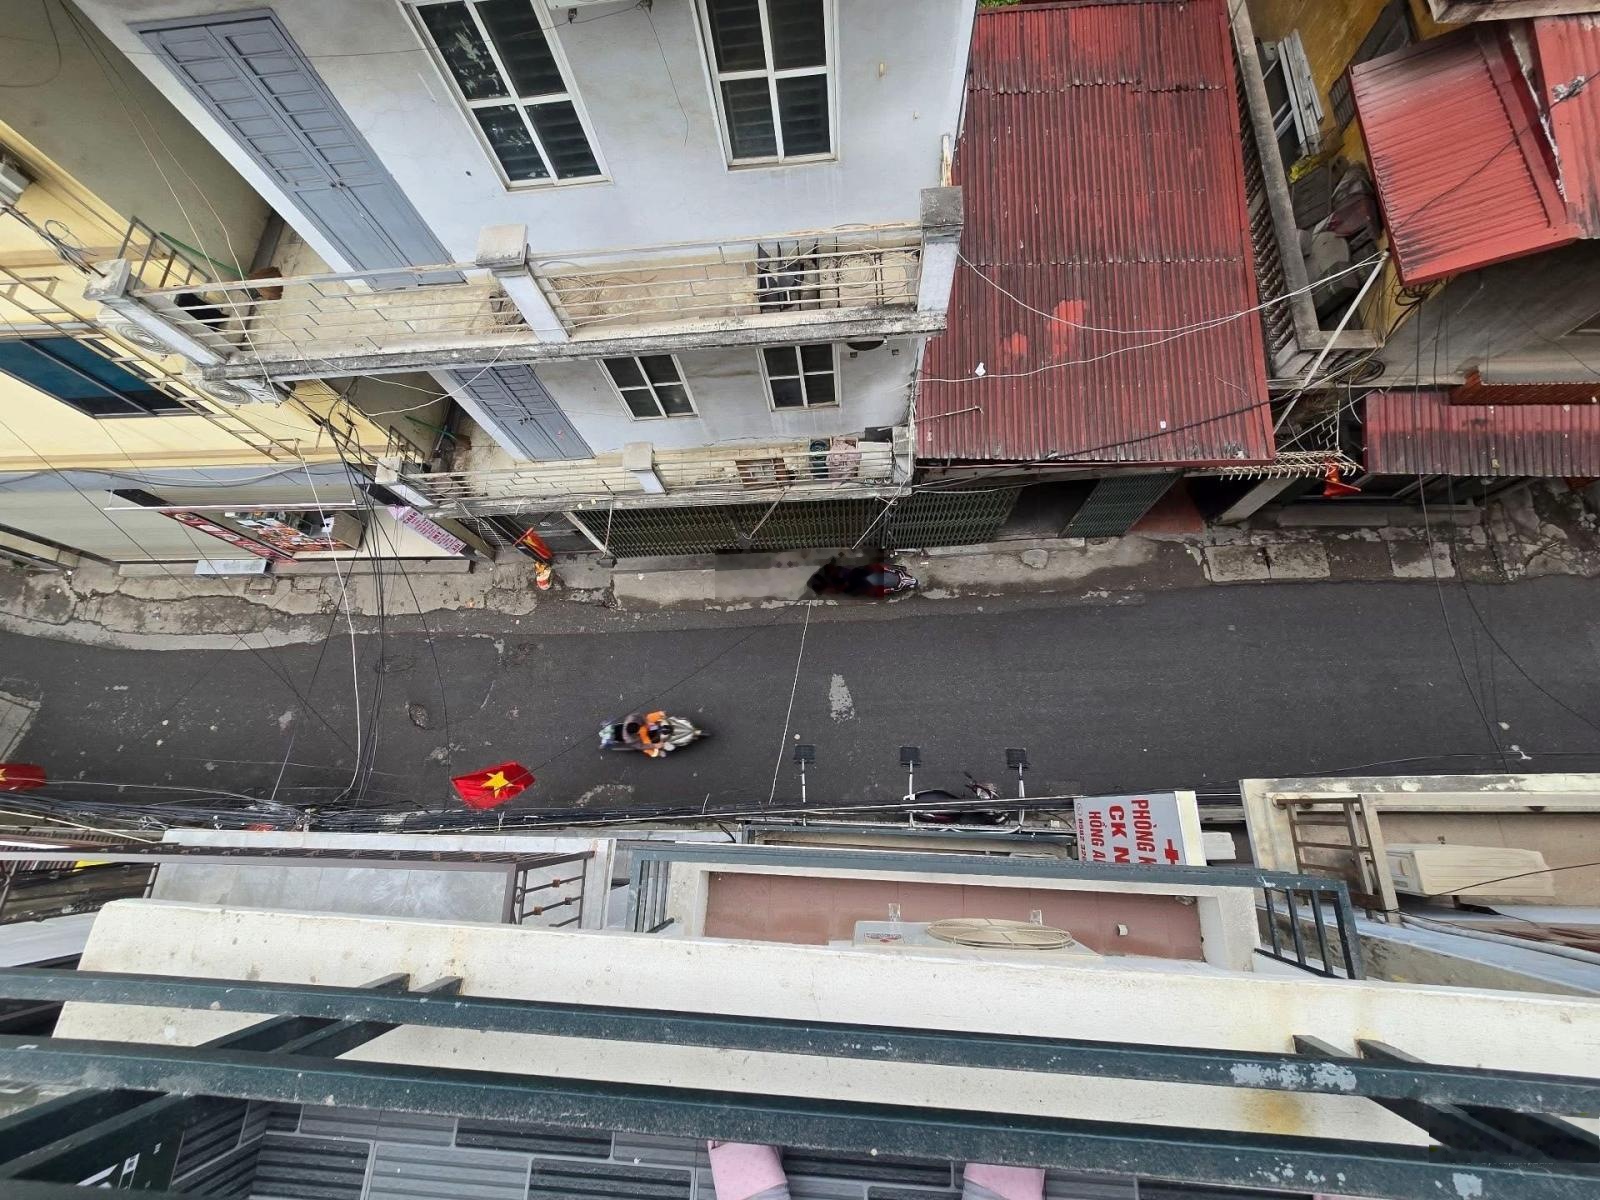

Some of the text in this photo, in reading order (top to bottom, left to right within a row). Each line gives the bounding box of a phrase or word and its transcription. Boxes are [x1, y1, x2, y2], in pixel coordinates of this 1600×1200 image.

[1089, 811, 1107, 862] HỒNG A
[1109, 805, 1127, 838] CK
[1131, 800, 1157, 852] PHÒNG
